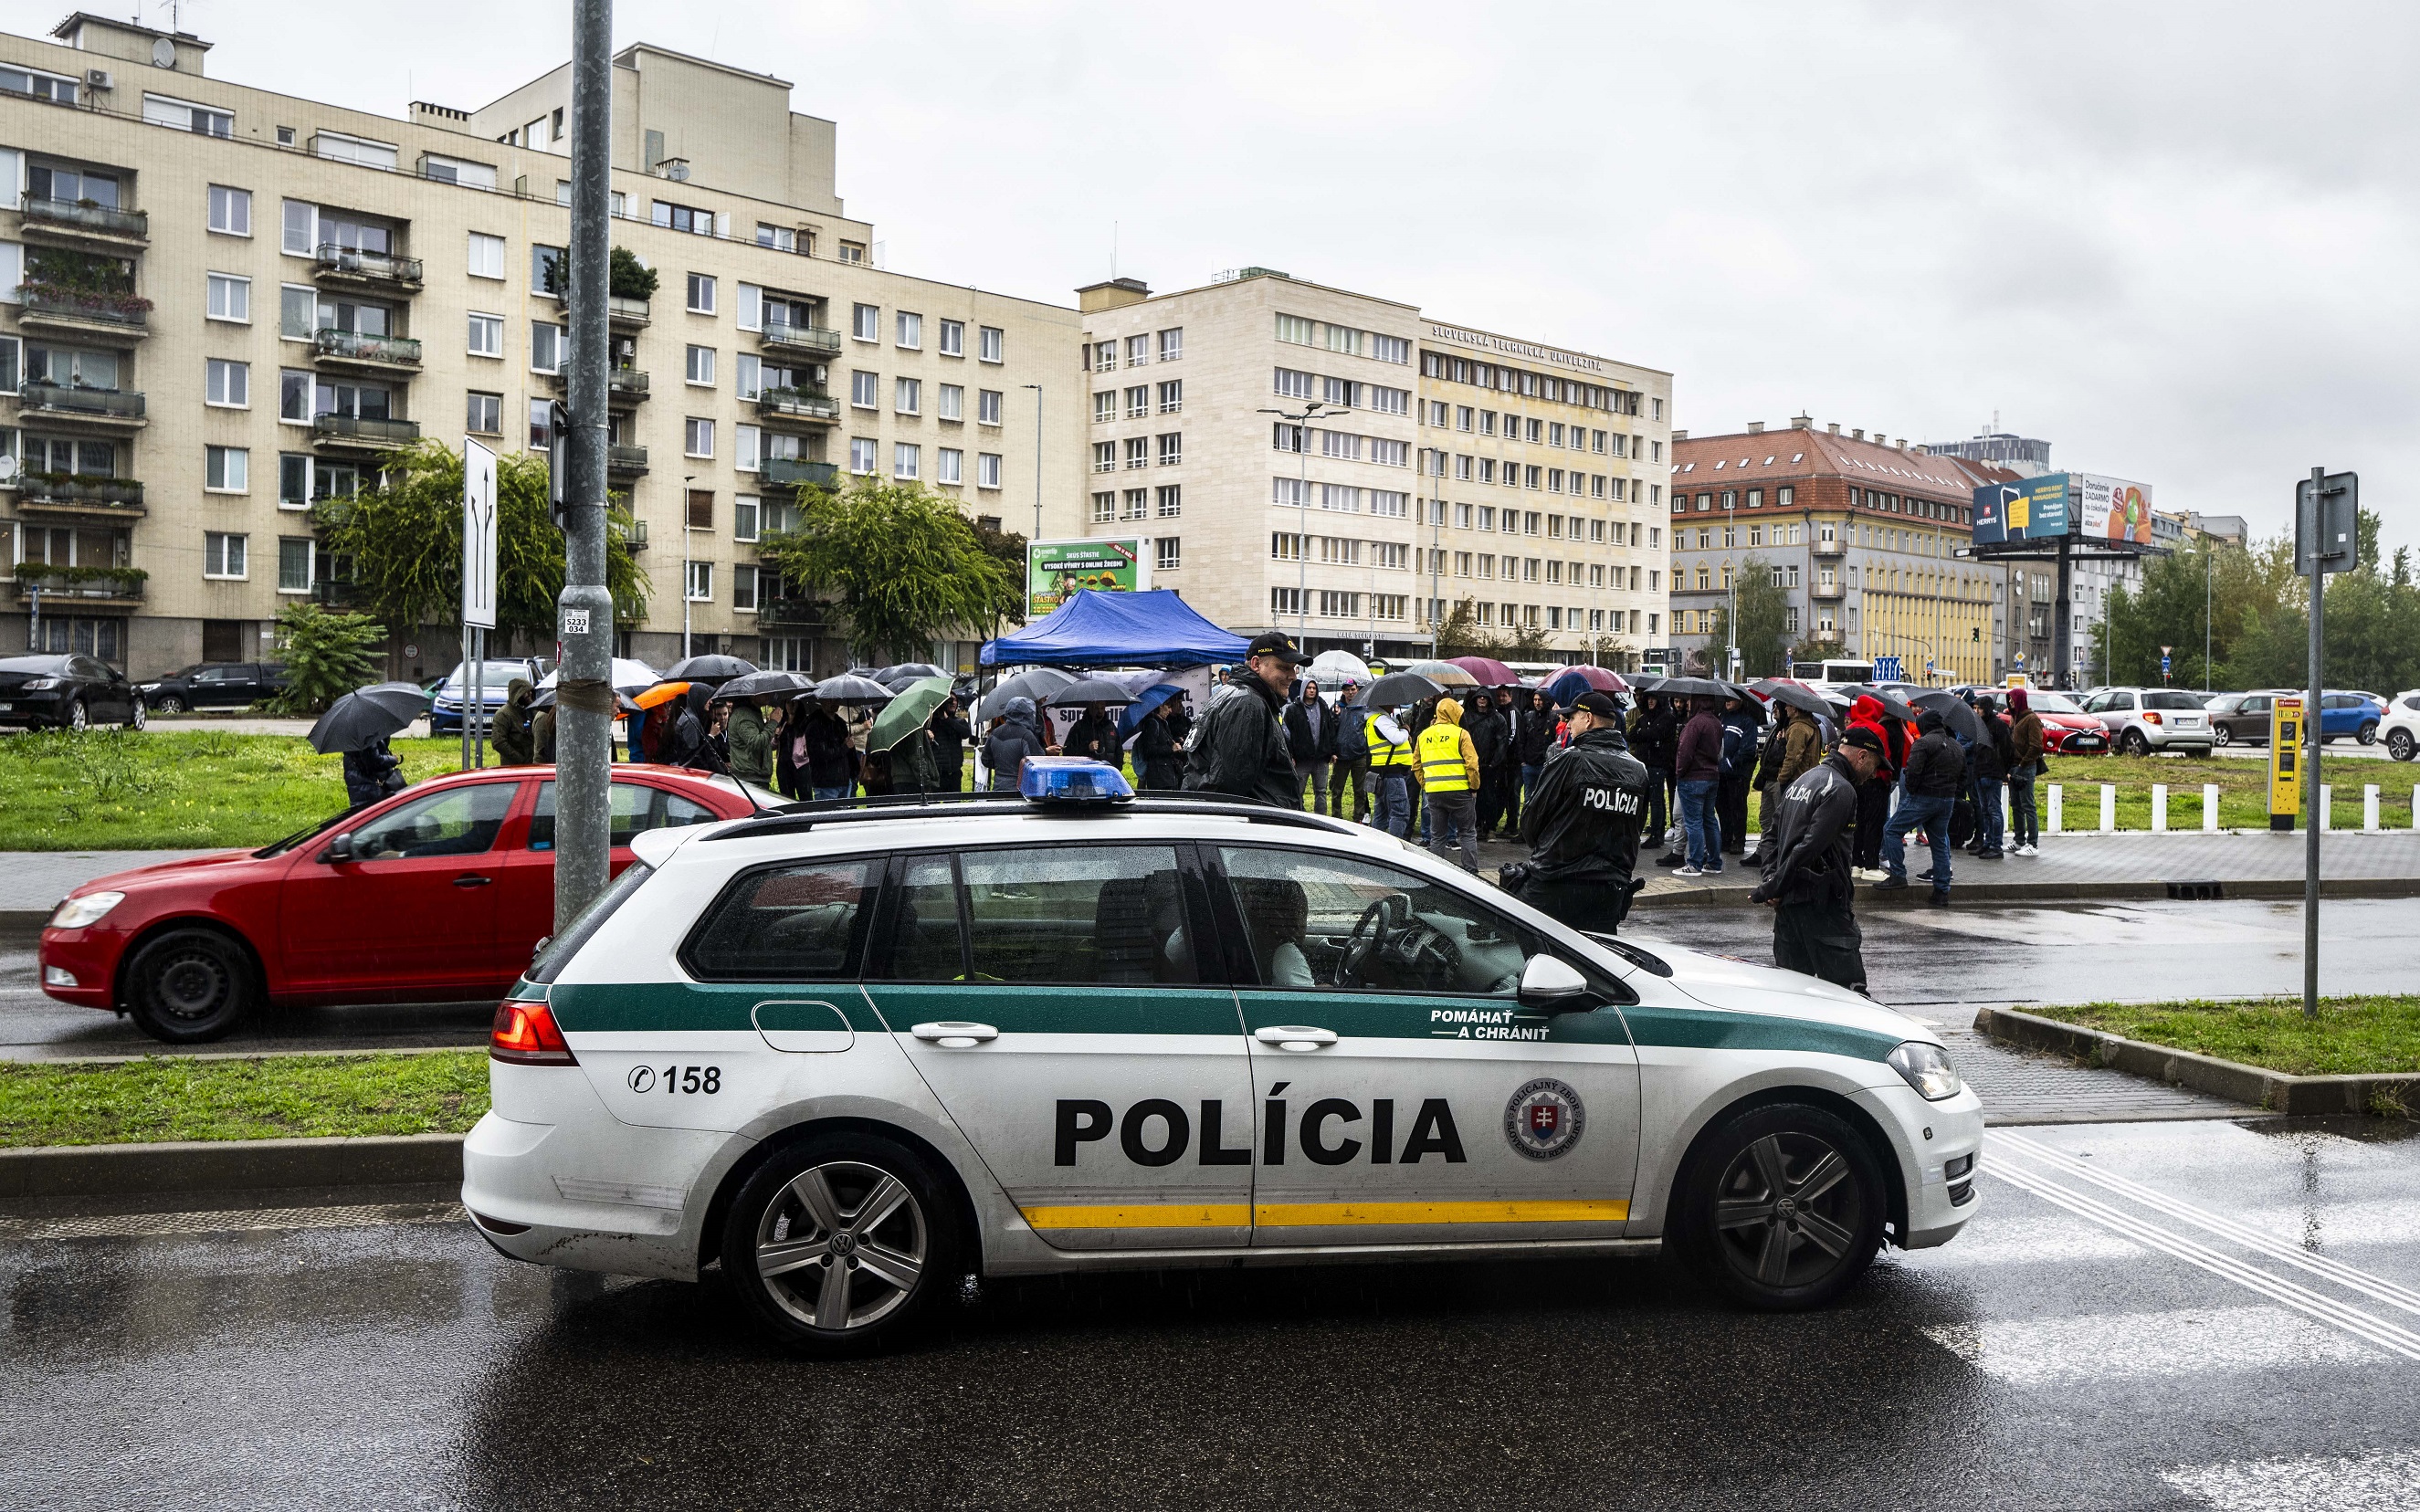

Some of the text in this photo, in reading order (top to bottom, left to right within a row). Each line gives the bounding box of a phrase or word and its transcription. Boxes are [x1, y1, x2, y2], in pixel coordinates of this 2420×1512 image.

[1433, 325, 1603, 372] SLOVENSKÁ TECHNICKÁ UNIVERZITA
[2085, 479, 2110, 493] Doručenie
[2032, 491, 2063, 501] MANAGEMENT
[2085, 491, 2110, 503] ZADARMO
[1976, 517, 1997, 526] HERRYS
[1044, 562, 1064, 570] VYSOKÉ
[1064, 561, 1080, 569] VÝHRY
[1085, 561, 1103, 569] ONLINE
[1103, 559, 1123, 568] ŽREBMI
[1583, 787, 1638, 815] POLÍCIA
[1430, 1008, 1513, 1024] POMÁHAŤ
[1457, 1025, 1550, 1040] A CHRÁNIŤ
[663, 1066, 721, 1094] 158
[1510, 1080, 1580, 1113] POLICAJNÝ ZBOR
[1054, 1081, 1468, 1167] POLÍCIA
[1507, 1118, 1582, 1160] SLOVENSKEJ REPUBLIKY
